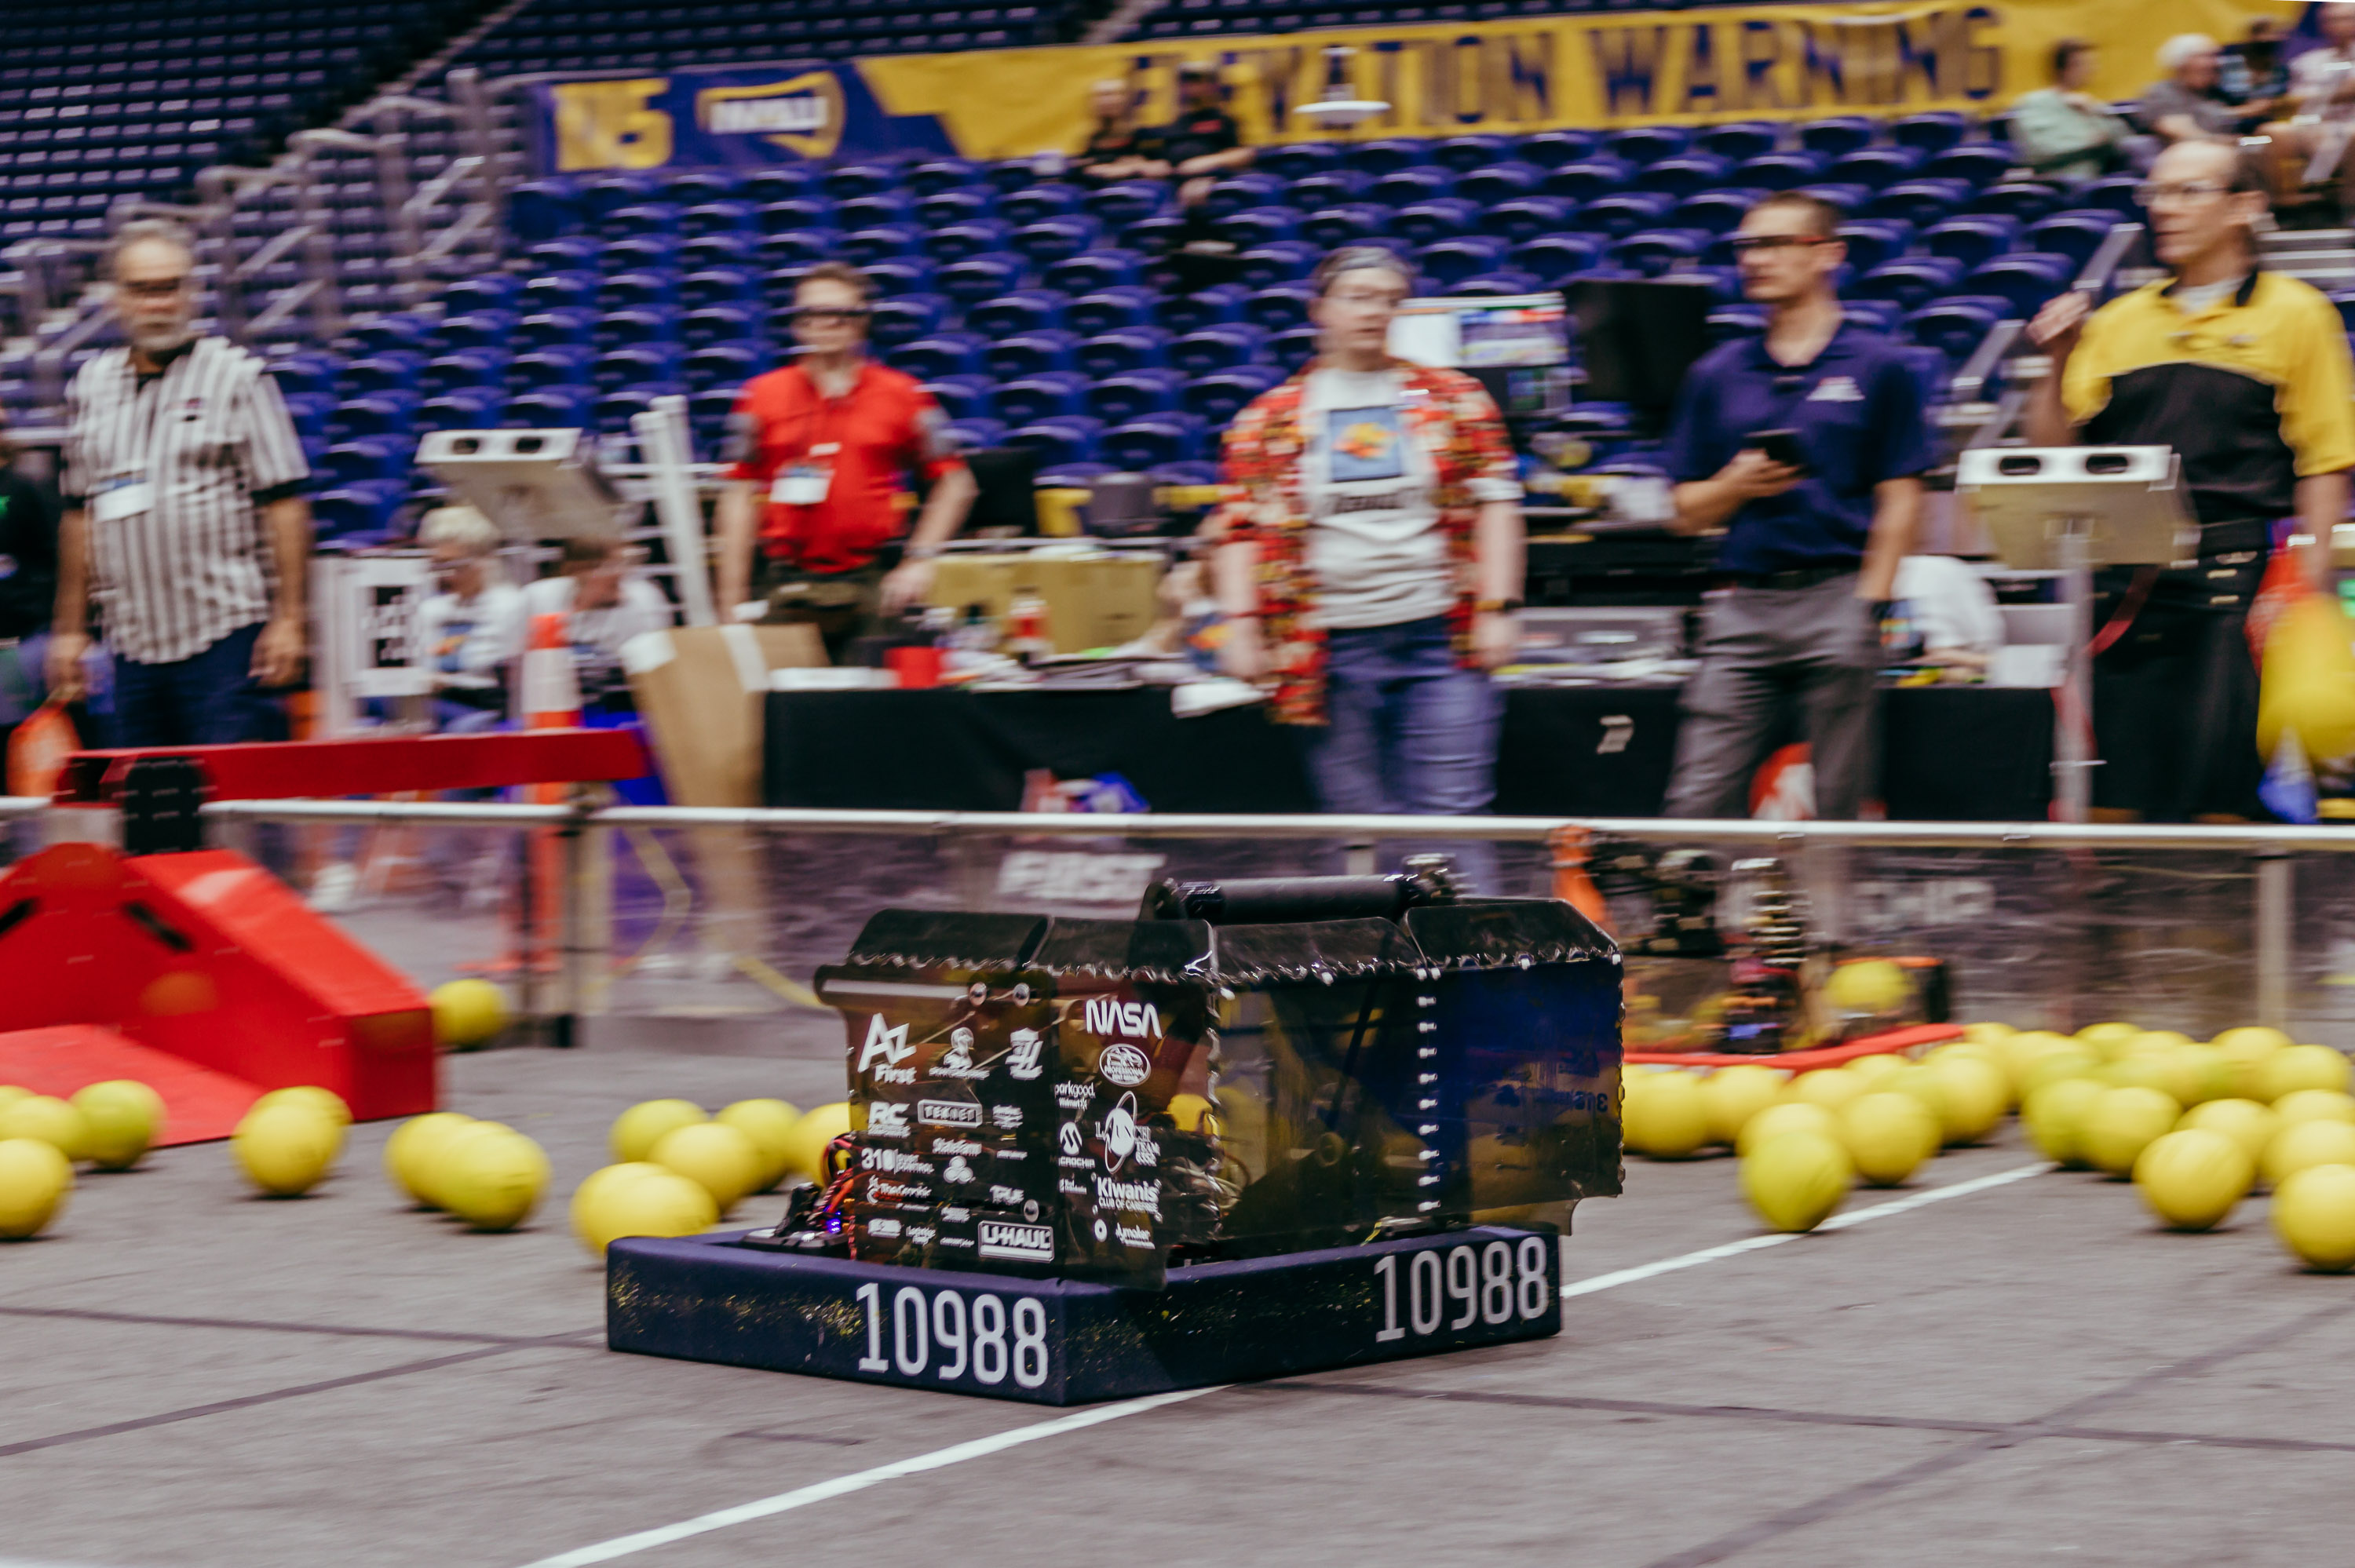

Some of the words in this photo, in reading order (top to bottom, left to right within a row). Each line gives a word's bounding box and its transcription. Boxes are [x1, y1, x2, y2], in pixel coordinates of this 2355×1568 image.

[1587, 7, 2001, 115] WARNING
[1086, 999, 1163, 1039] NASA
[874, 1063, 917, 1085] First
[1097, 1177, 1159, 1203] Kiwanis
[1375, 1236, 1549, 1342] 10988
[856, 1282, 1050, 1387] 10988
